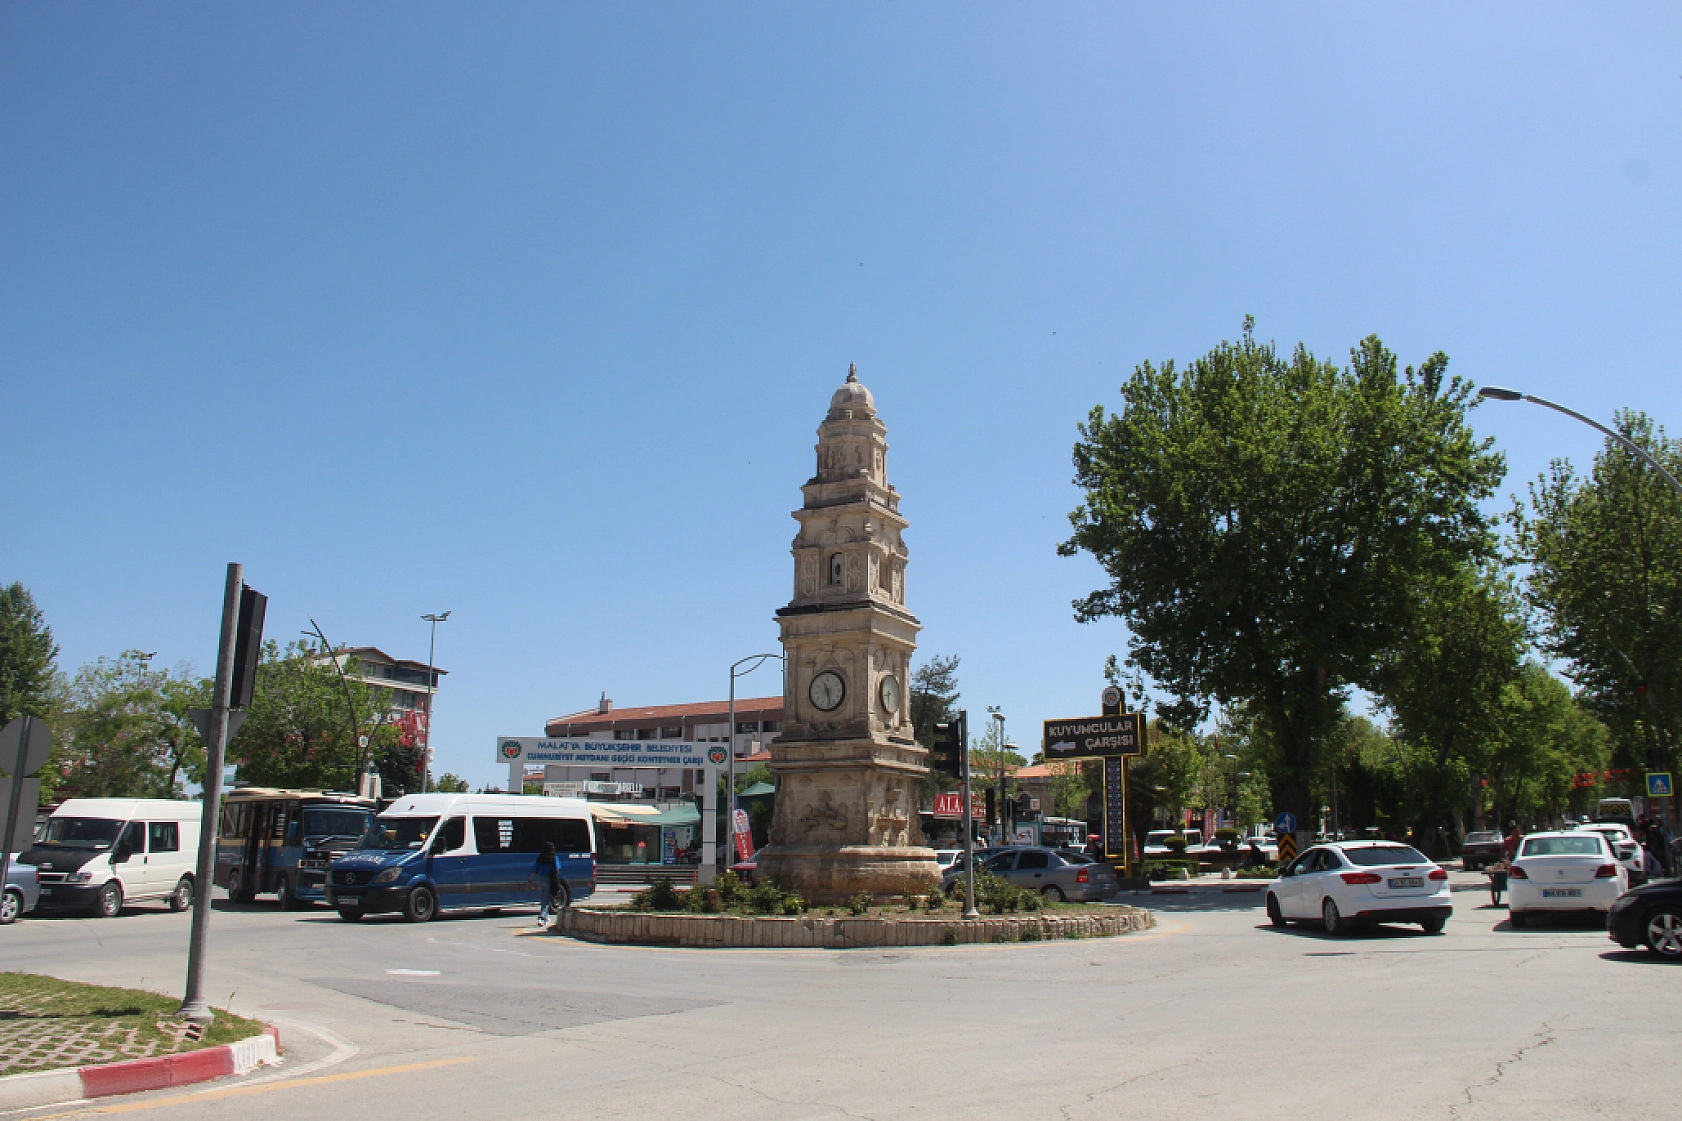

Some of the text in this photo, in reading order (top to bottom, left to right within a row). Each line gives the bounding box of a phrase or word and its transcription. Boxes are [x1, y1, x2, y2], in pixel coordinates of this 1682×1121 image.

[1049, 720, 1133, 737] KUYUMCULAR
[537, 741, 581, 751] MALATYA
[937, 796, 964, 813] ALA
